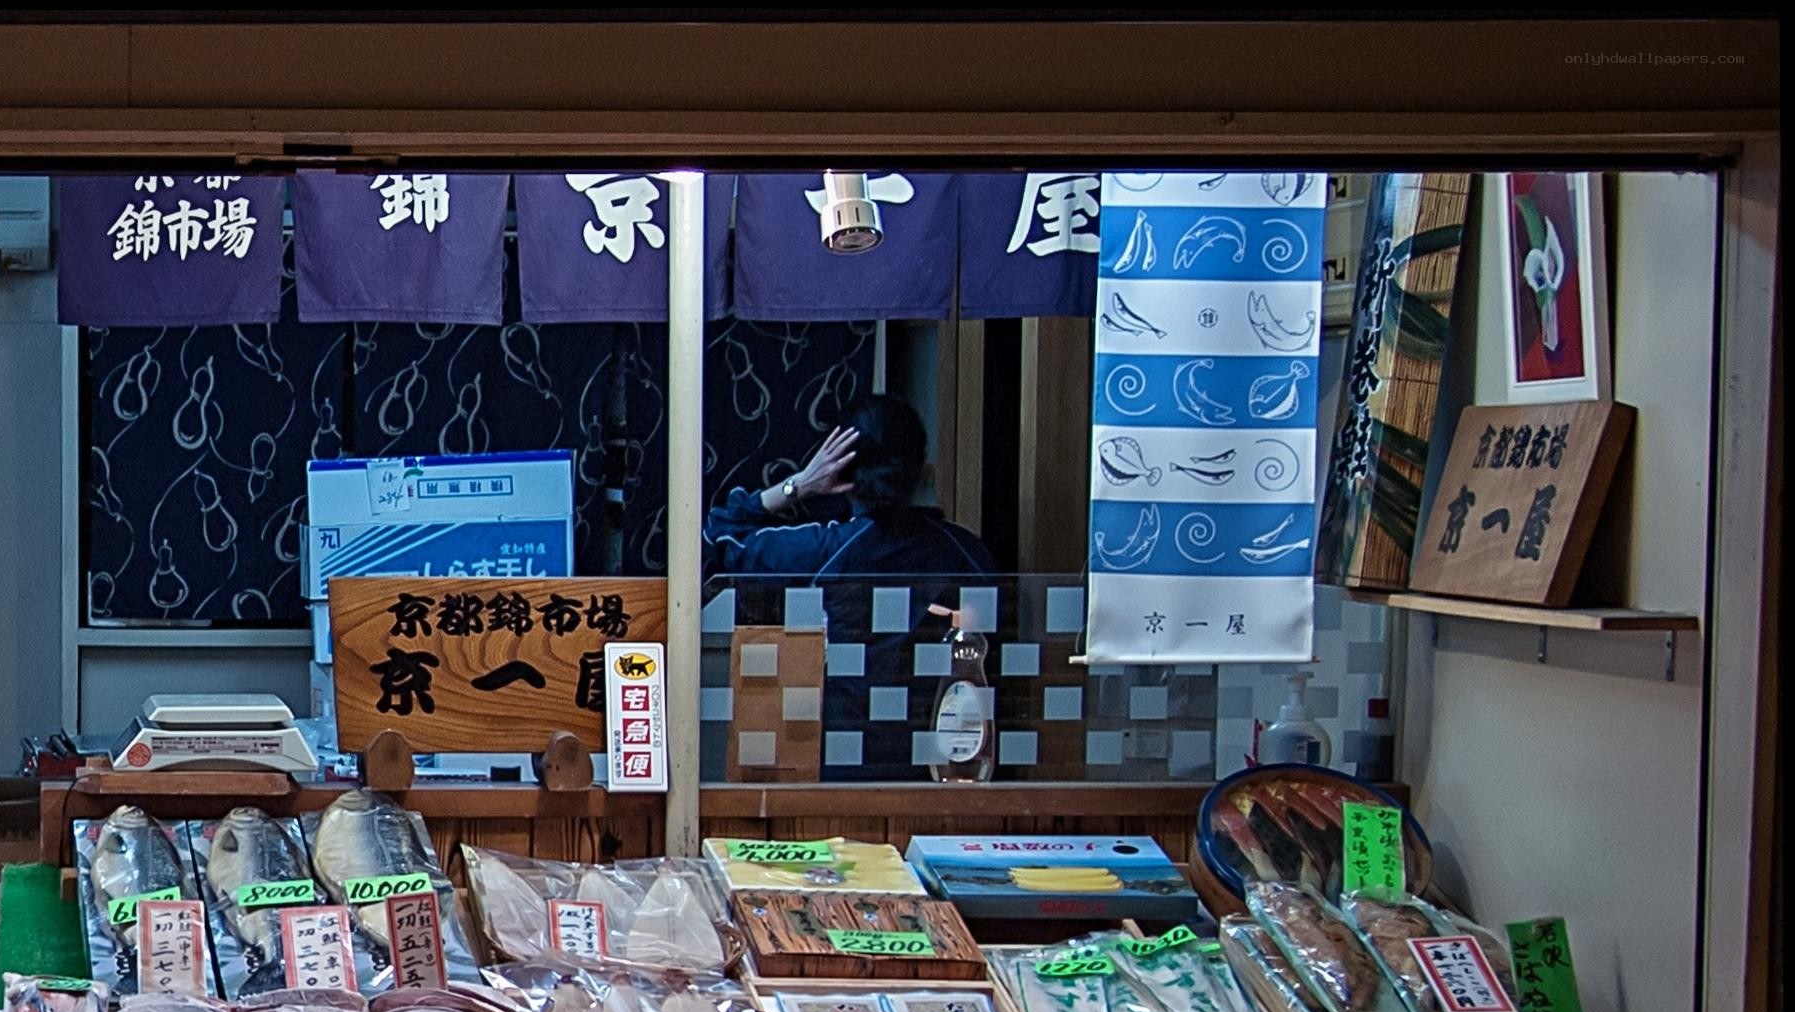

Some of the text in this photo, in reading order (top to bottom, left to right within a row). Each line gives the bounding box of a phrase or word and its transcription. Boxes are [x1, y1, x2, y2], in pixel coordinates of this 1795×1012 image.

[107, 198, 257, 262] 錦市場
[369, 174, 451, 232] 錦
[564, 173, 666, 264] 京
[1472, 422, 1570, 471] 京都錦市場
[319, 531, 340, 549] 九
[1437, 482, 1558, 561] 京一屋
[424, 557, 548, 577] しらす干し
[387, 592, 632, 638] 京都錦市場
[1143, 611, 1246, 637] 京一屋
[623, 686, 650, 777] 宅急便
[243, 884, 310, 903] 8000
